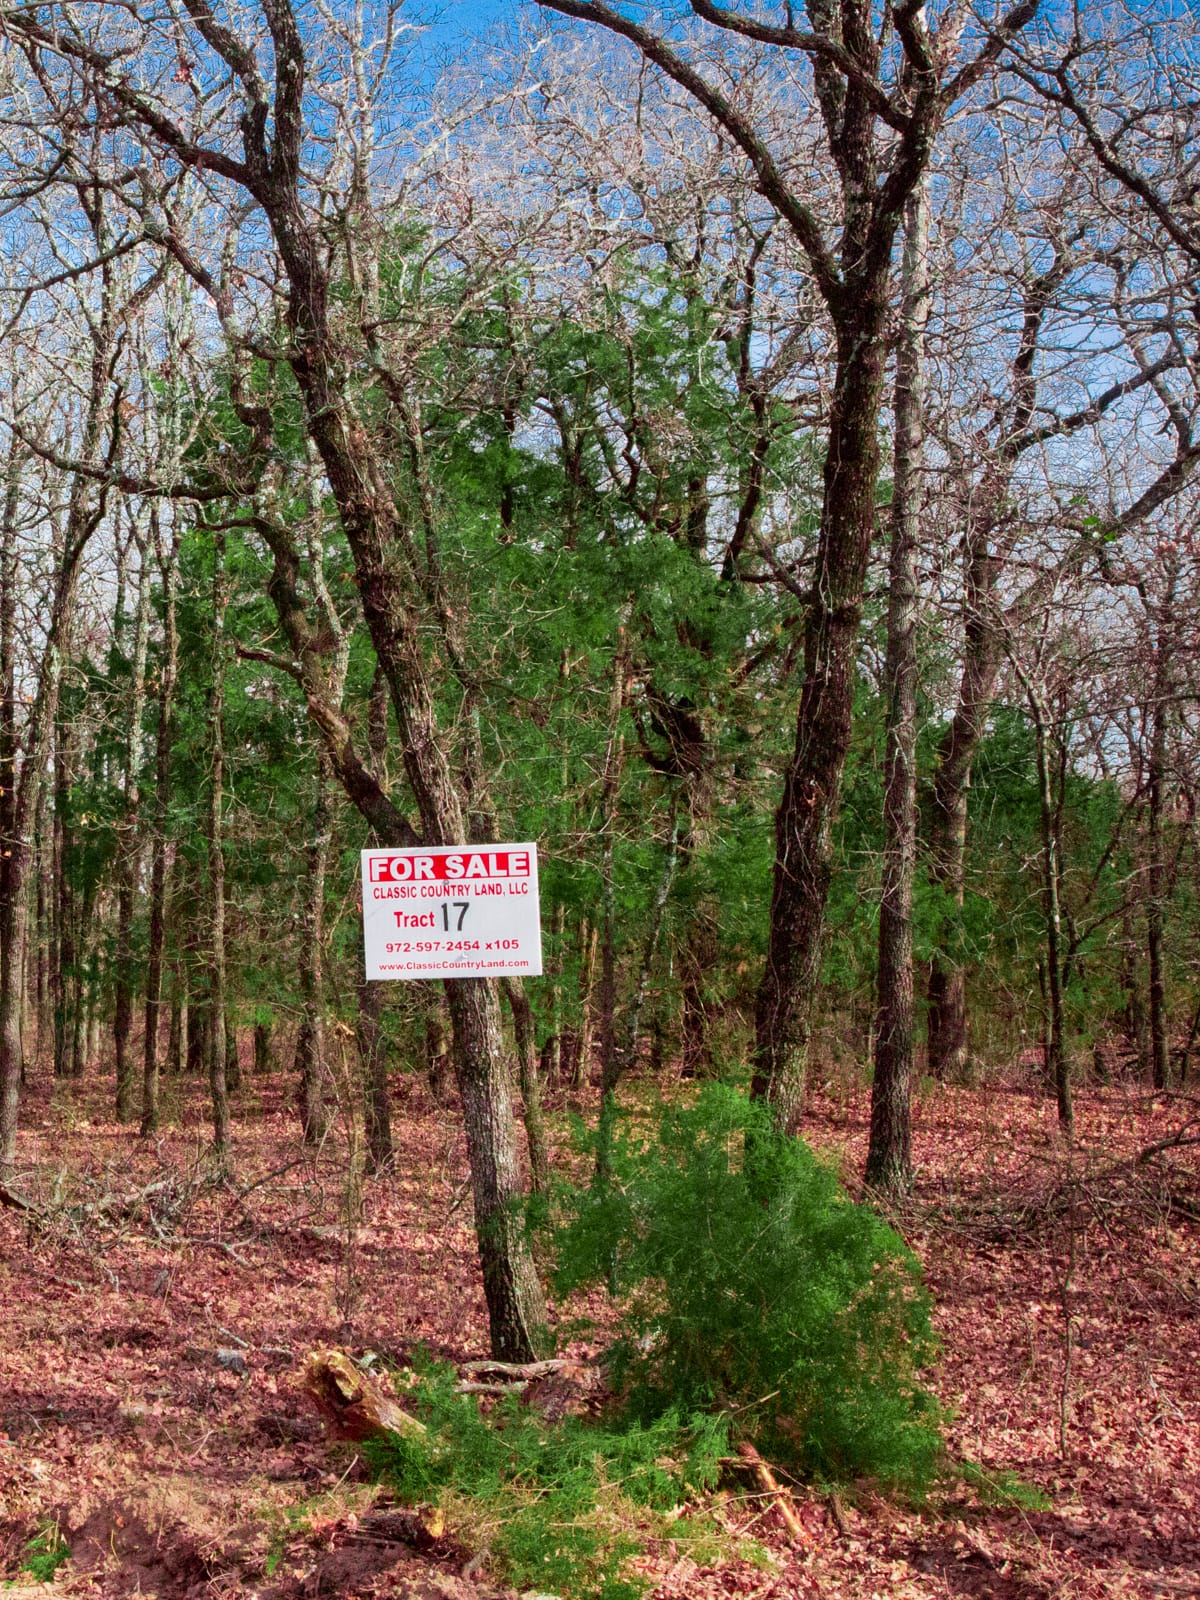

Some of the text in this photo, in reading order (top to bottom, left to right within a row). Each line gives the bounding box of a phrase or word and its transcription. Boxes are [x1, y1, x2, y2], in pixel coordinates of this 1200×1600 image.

[371, 853, 528, 880] FOR SALE
[374, 883, 528, 899] CLASSIC COUNTRY LAND, LLC
[394, 902, 470, 931] Tract 17
[386, 940, 519, 953] 972-597-2454 x105
[379, 960, 528, 970] www.ClassicCountryLand.com
